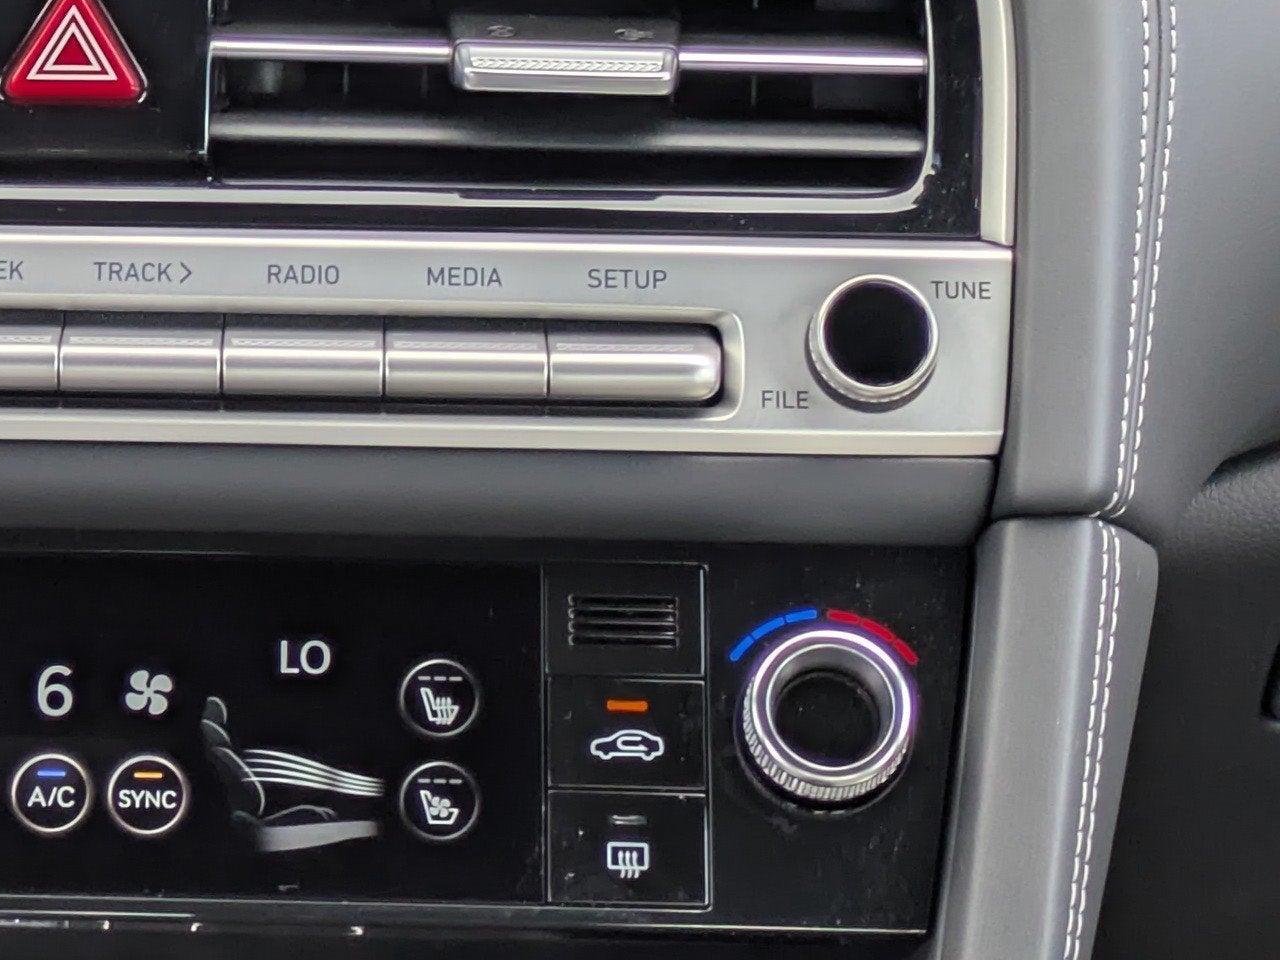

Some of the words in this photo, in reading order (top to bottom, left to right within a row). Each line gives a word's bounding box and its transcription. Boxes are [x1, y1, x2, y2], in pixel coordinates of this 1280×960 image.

[93, 261, 173, 283] TRACK
[266, 264, 340, 286] RADIO
[426, 267, 503, 288] MEDIA
[586, 269, 668, 290] SETUP
[931, 281, 991, 301] TUNE
[761, 390, 810, 410] FILE
[279, 640, 332, 675] LO
[37, 664, 75, 718] 6
[26, 786, 76, 808] A/C
[118, 789, 177, 810] SYNC
